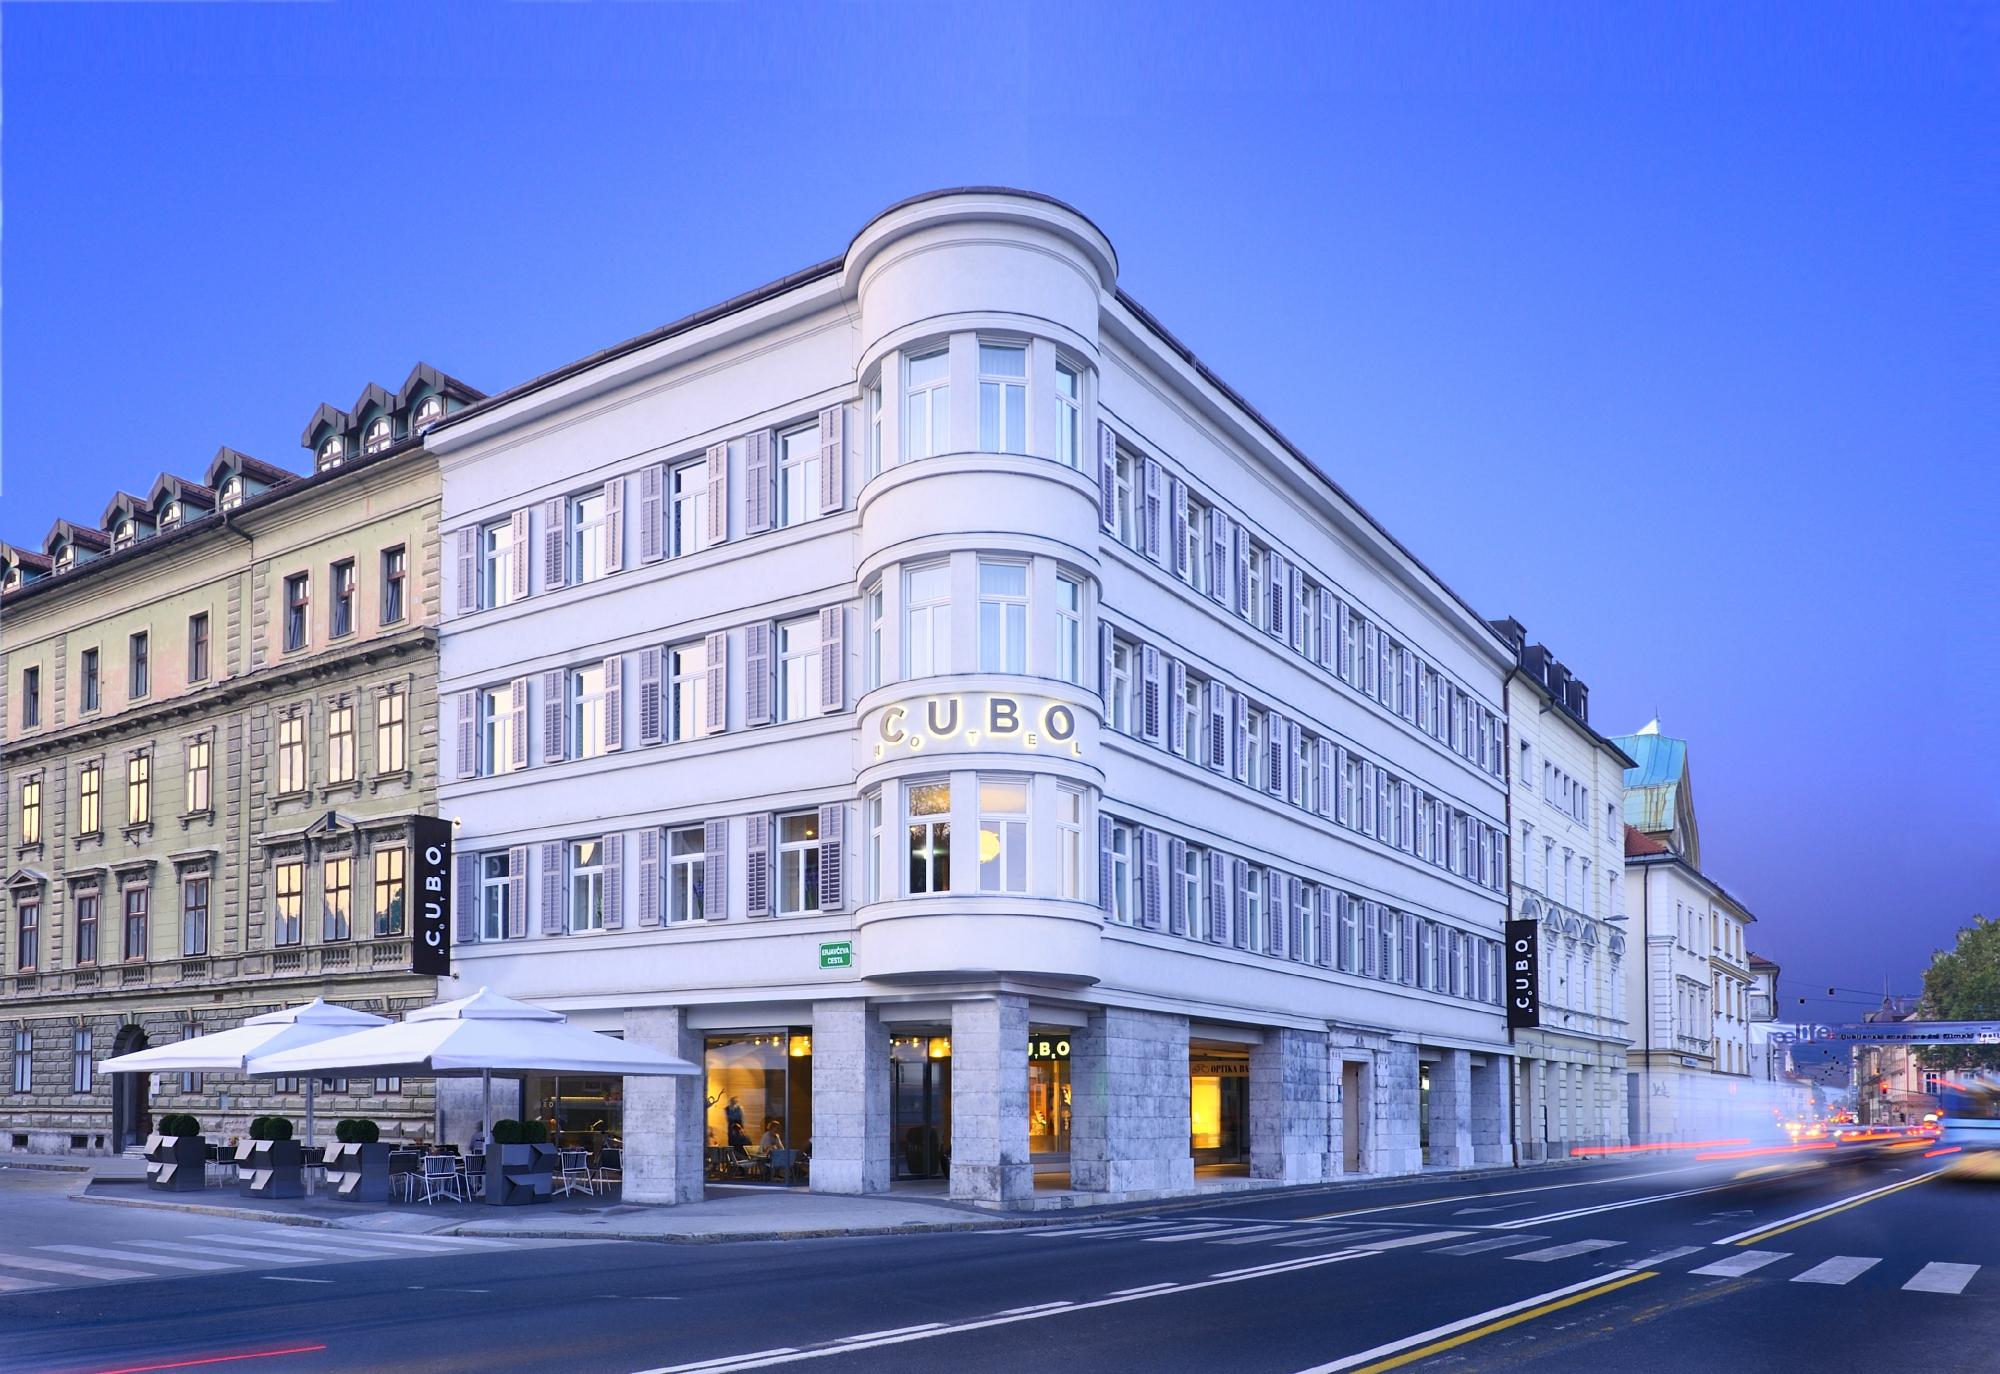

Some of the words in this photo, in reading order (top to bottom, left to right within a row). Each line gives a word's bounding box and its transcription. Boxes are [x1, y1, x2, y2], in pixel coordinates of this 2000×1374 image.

[879, 698, 1075, 743] CUBO
[425, 846, 442, 947] CUBO
[1515, 939, 1529, 1009] CUBO
